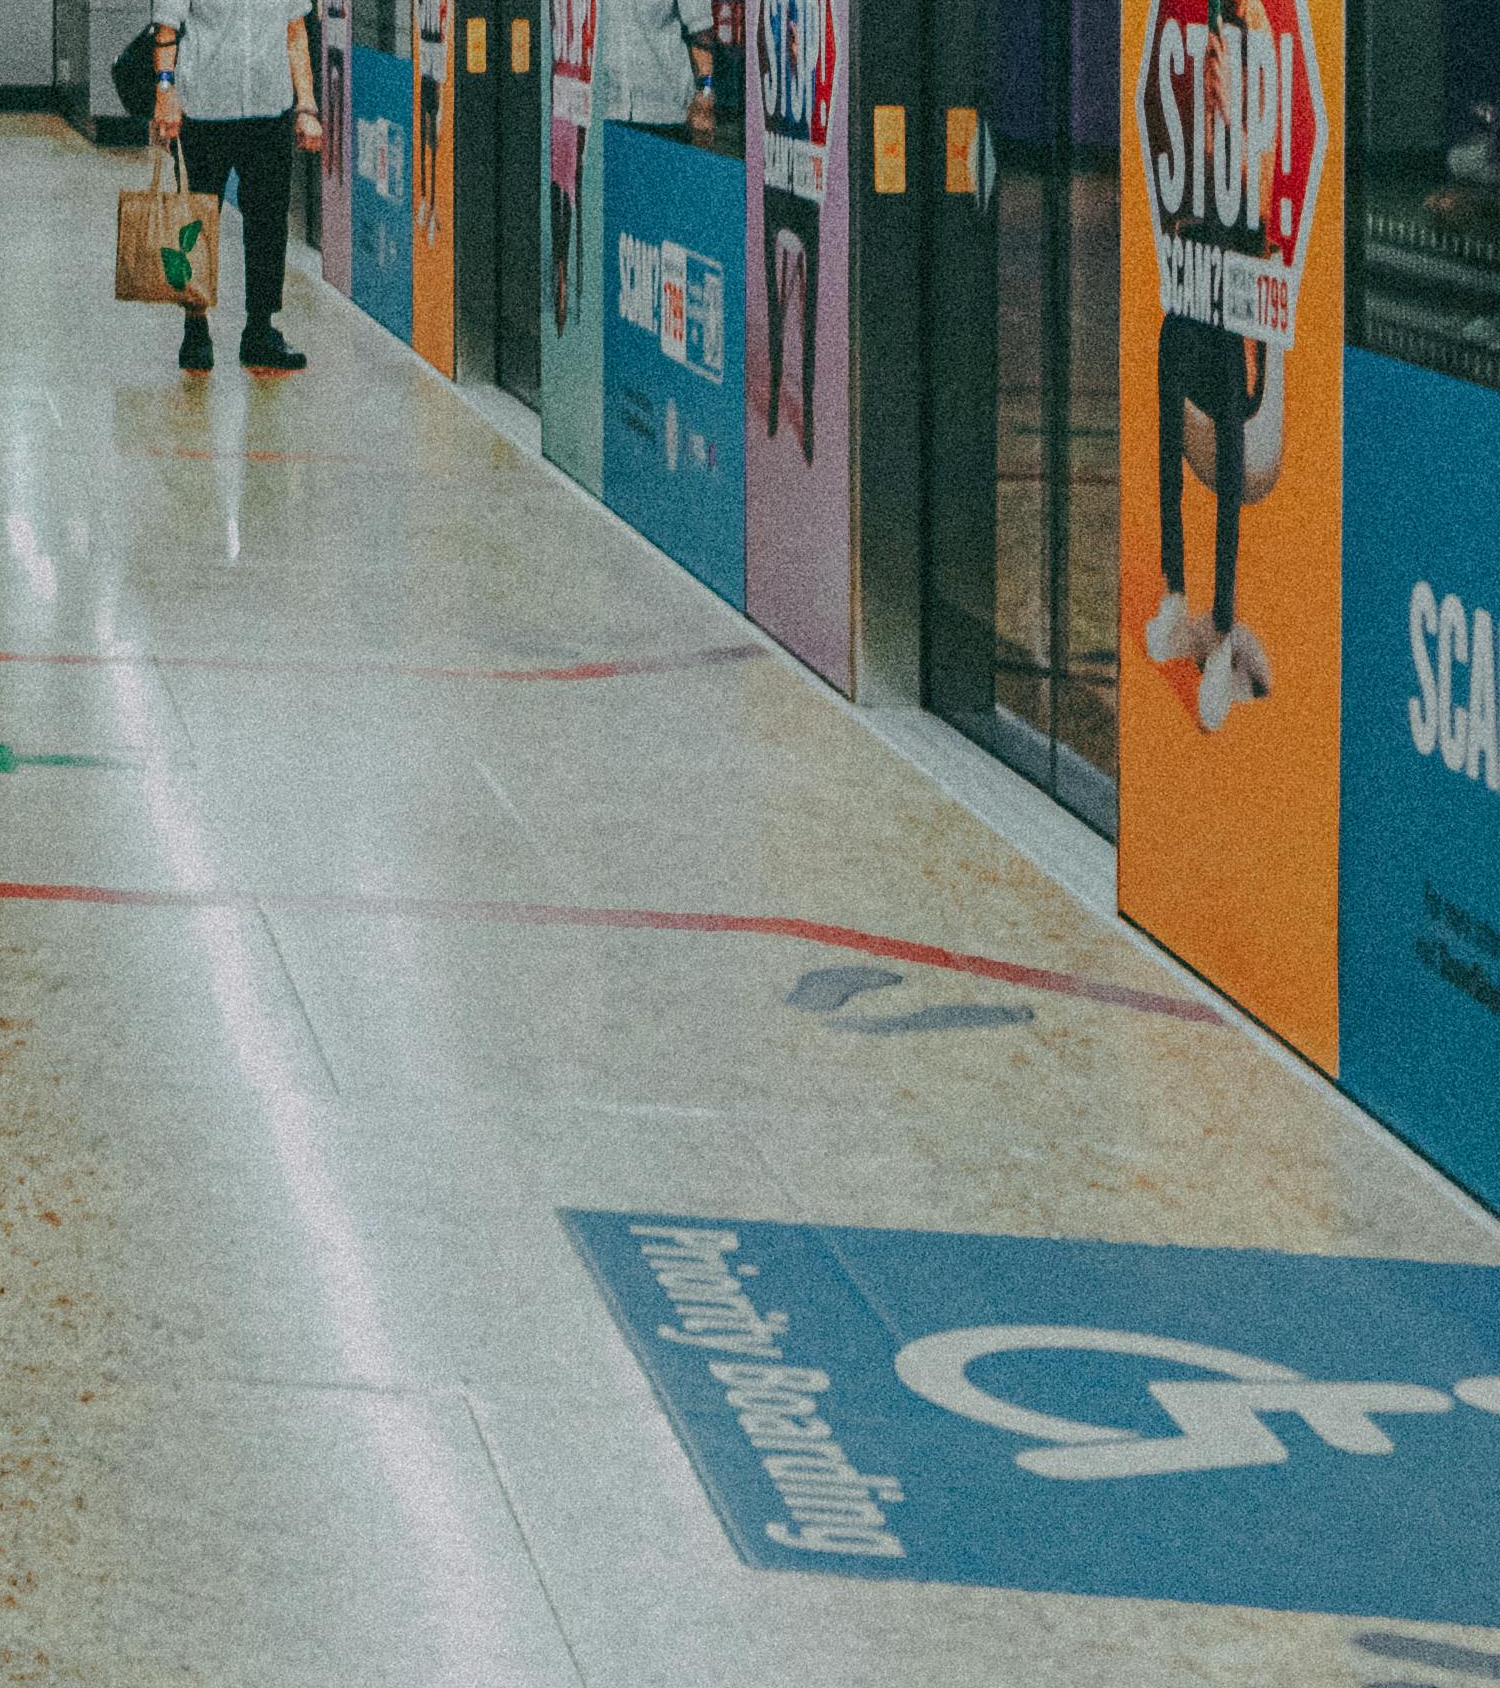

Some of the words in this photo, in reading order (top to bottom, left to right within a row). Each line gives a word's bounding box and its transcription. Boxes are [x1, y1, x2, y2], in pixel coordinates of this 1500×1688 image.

[1156, 16, 1294, 239] STOP!
[1160, 232, 1221, 328] SCAM?
[1257, 275, 1288, 332] 1799
[629, 1223, 791, 1359] Priority
[707, 1358, 907, 1558] Boarding
